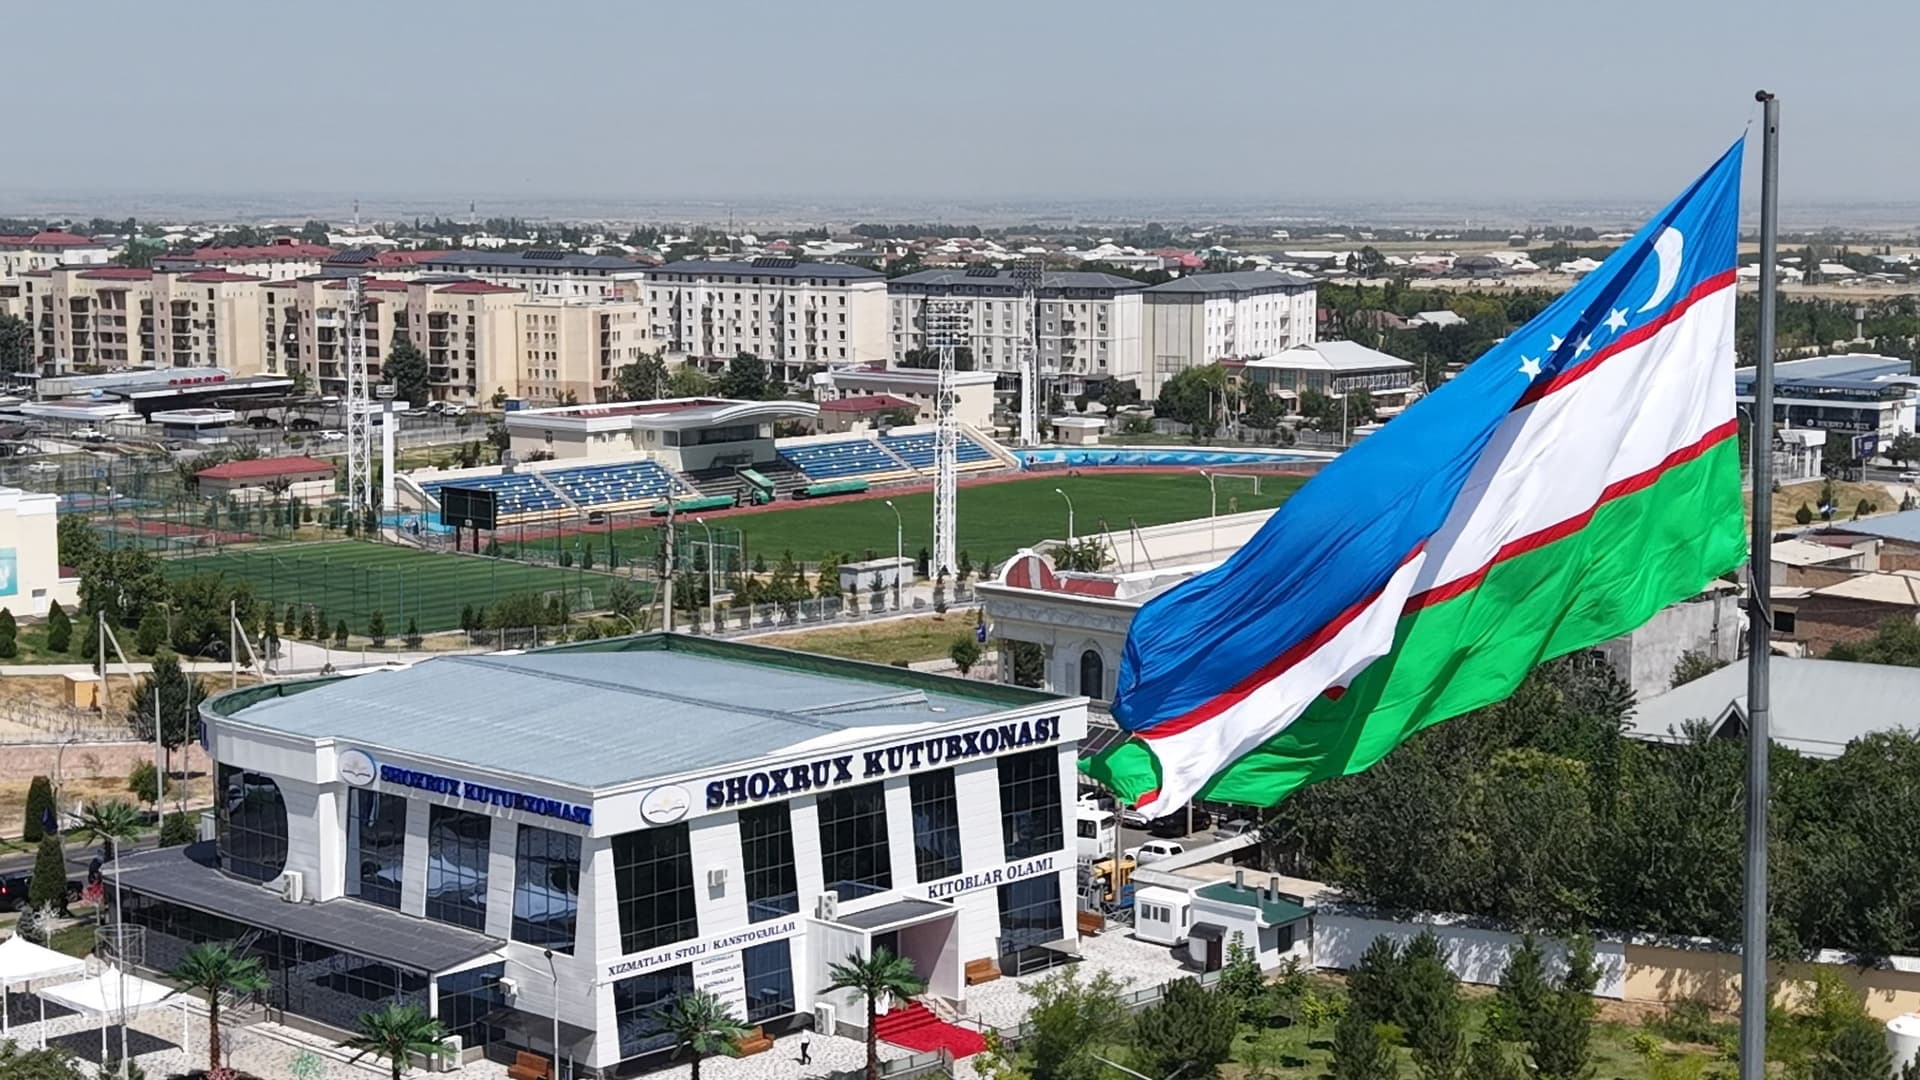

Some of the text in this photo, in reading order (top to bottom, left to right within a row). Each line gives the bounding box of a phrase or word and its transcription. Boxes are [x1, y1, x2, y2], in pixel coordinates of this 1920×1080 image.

[706, 715, 1061, 811] SHOXRUX KUTUBXONASI
[928, 857, 1053, 899] KITOBLAR OLAMI
[608, 952, 672, 977] XIZMATLAR
